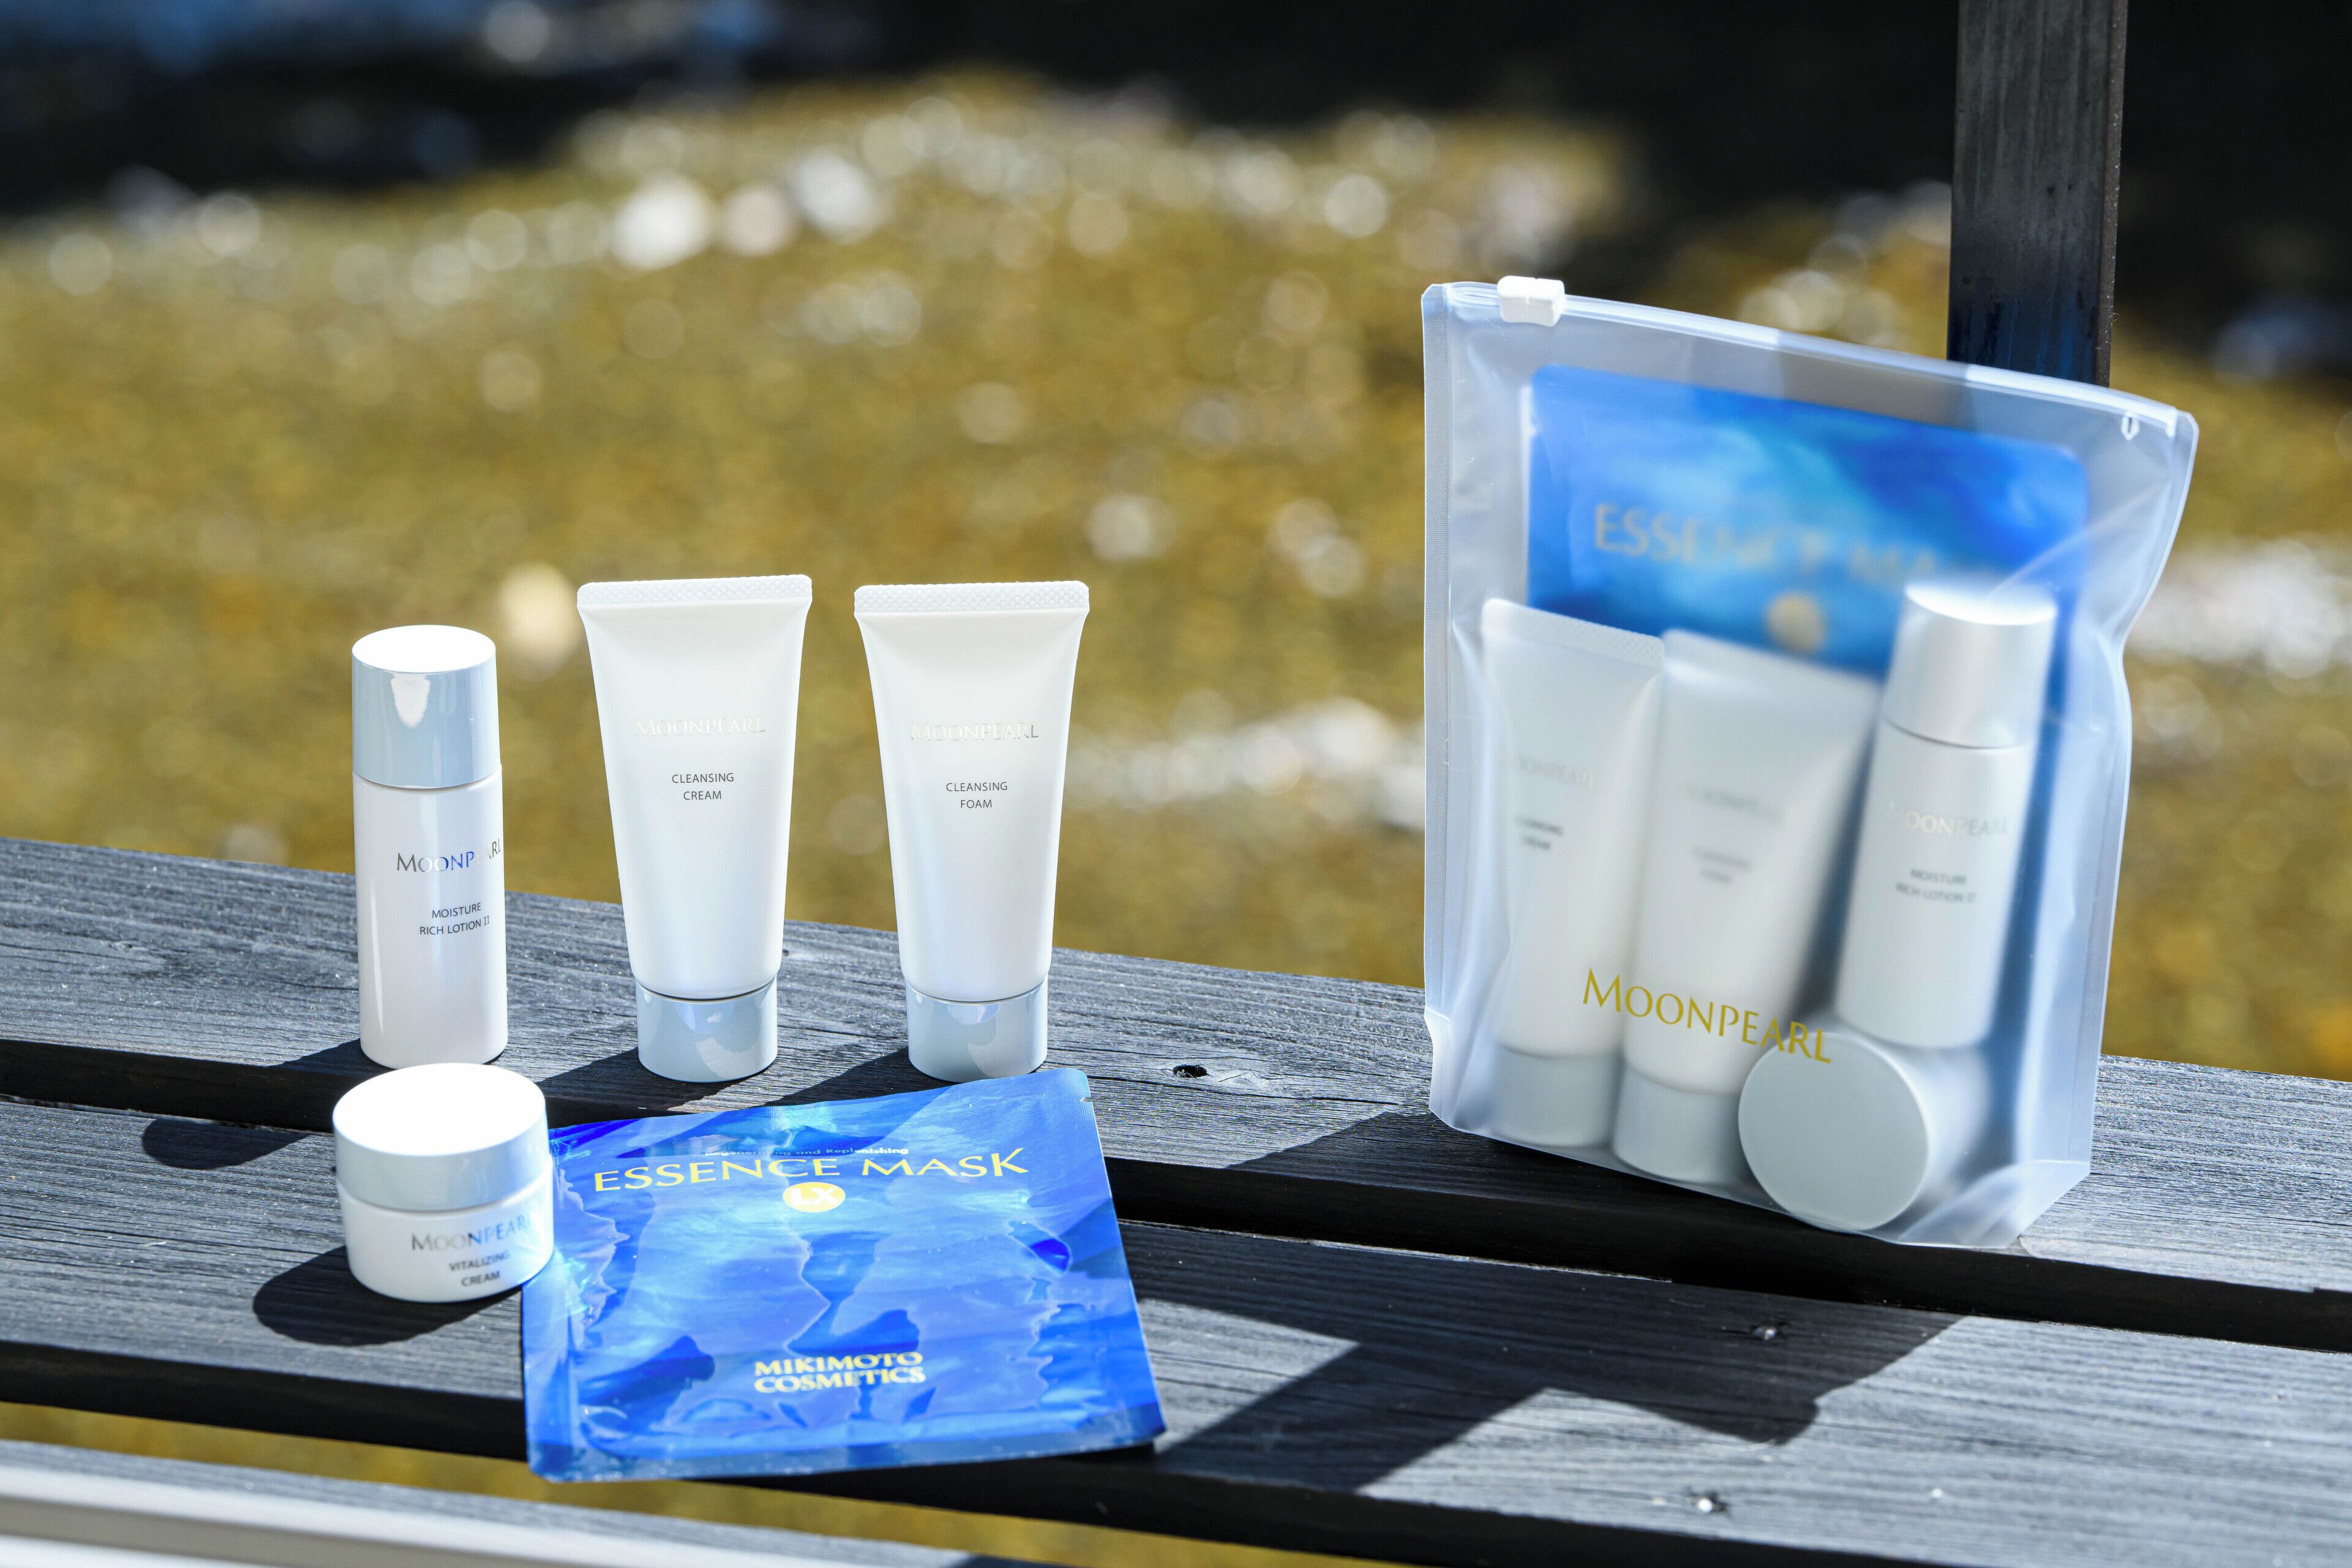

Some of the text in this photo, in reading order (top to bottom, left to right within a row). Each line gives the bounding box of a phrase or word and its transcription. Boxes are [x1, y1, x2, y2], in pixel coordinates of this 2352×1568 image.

[635, 715, 765, 736] MOONPEARL
[911, 720, 1039, 741] MOONPEARL
[671, 772, 734, 783] CLEANSING
[946, 782, 1008, 792] CLEANSING
[683, 790, 722, 801] CREAM
[960, 799, 992, 809] FOAM
[432, 902, 481, 919] MOISTURE
[420, 925, 444, 935] RICH
[447, 919, 481, 934] LOTION
[1582, 967, 1832, 1063] MOONPEARL
[594, 1147, 1029, 1192] ESSENCE MASK
[790, 1187, 838, 1206] LX
[448, 1251, 510, 1271] VITALIZING
[461, 1270, 500, 1287] CREAM
[754, 1352, 924, 1378] MIKIMOTO
[754, 1366, 926, 1393] COSMETICS
